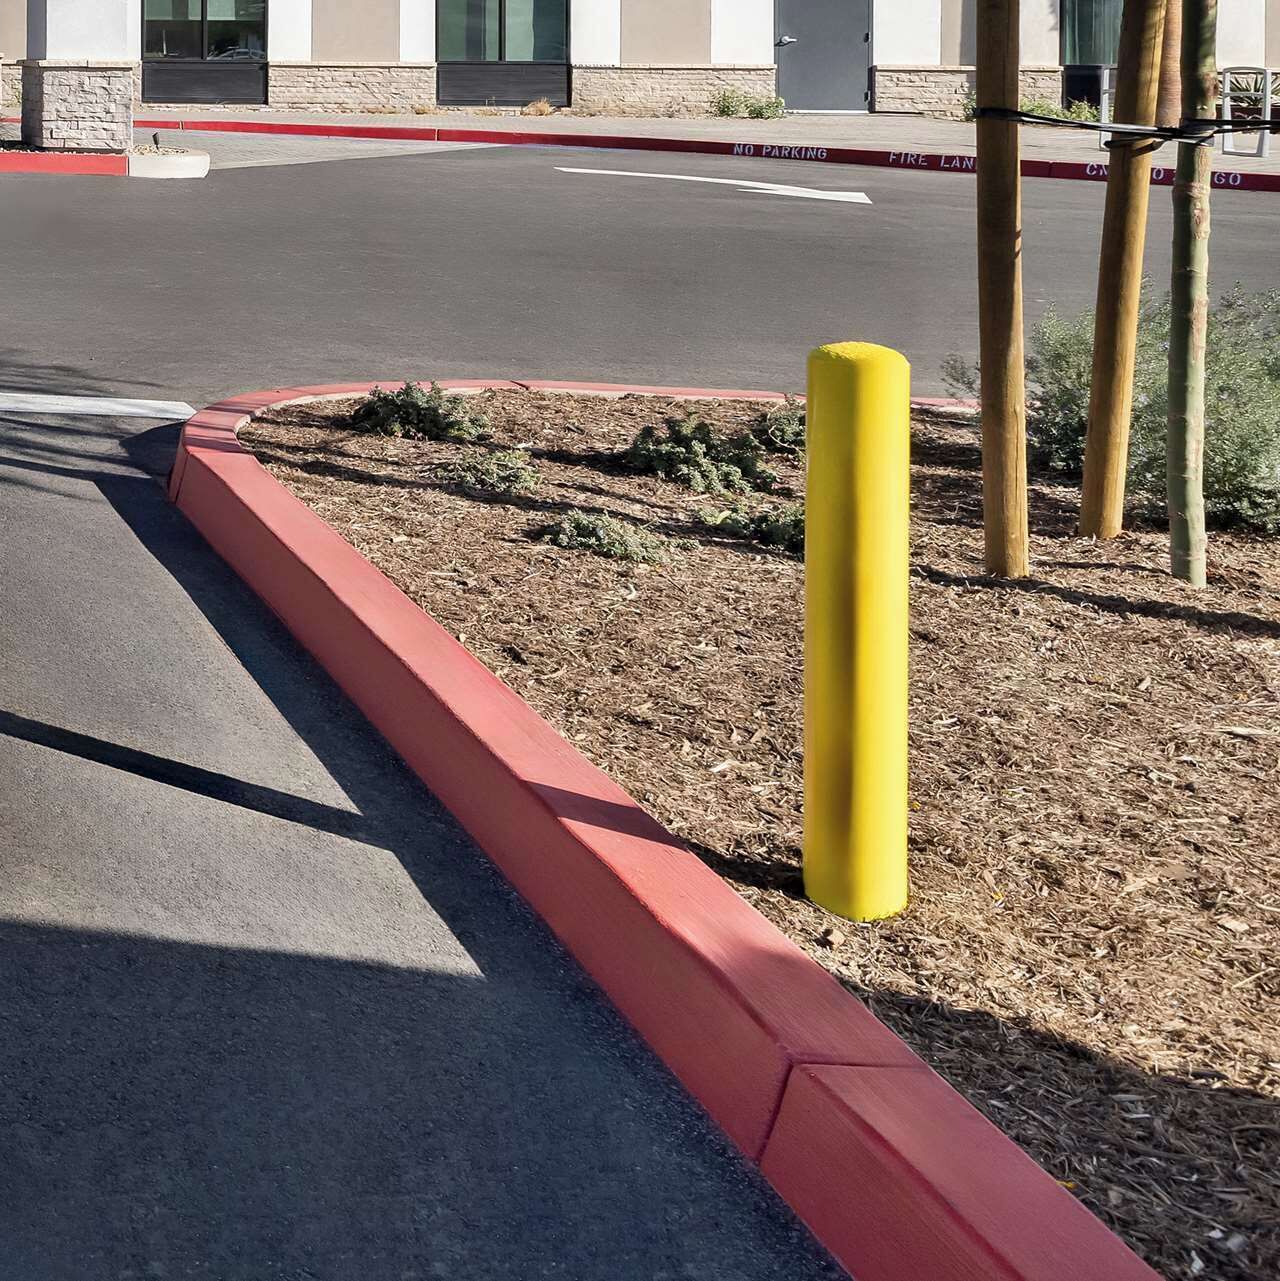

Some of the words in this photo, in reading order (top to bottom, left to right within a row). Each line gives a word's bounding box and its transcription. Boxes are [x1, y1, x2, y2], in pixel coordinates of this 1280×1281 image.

[733, 144, 754, 156] NO
[762, 145, 828, 160] PARKING
[889, 152, 928, 166] FIRE
[940, 155, 974, 170] LAN
